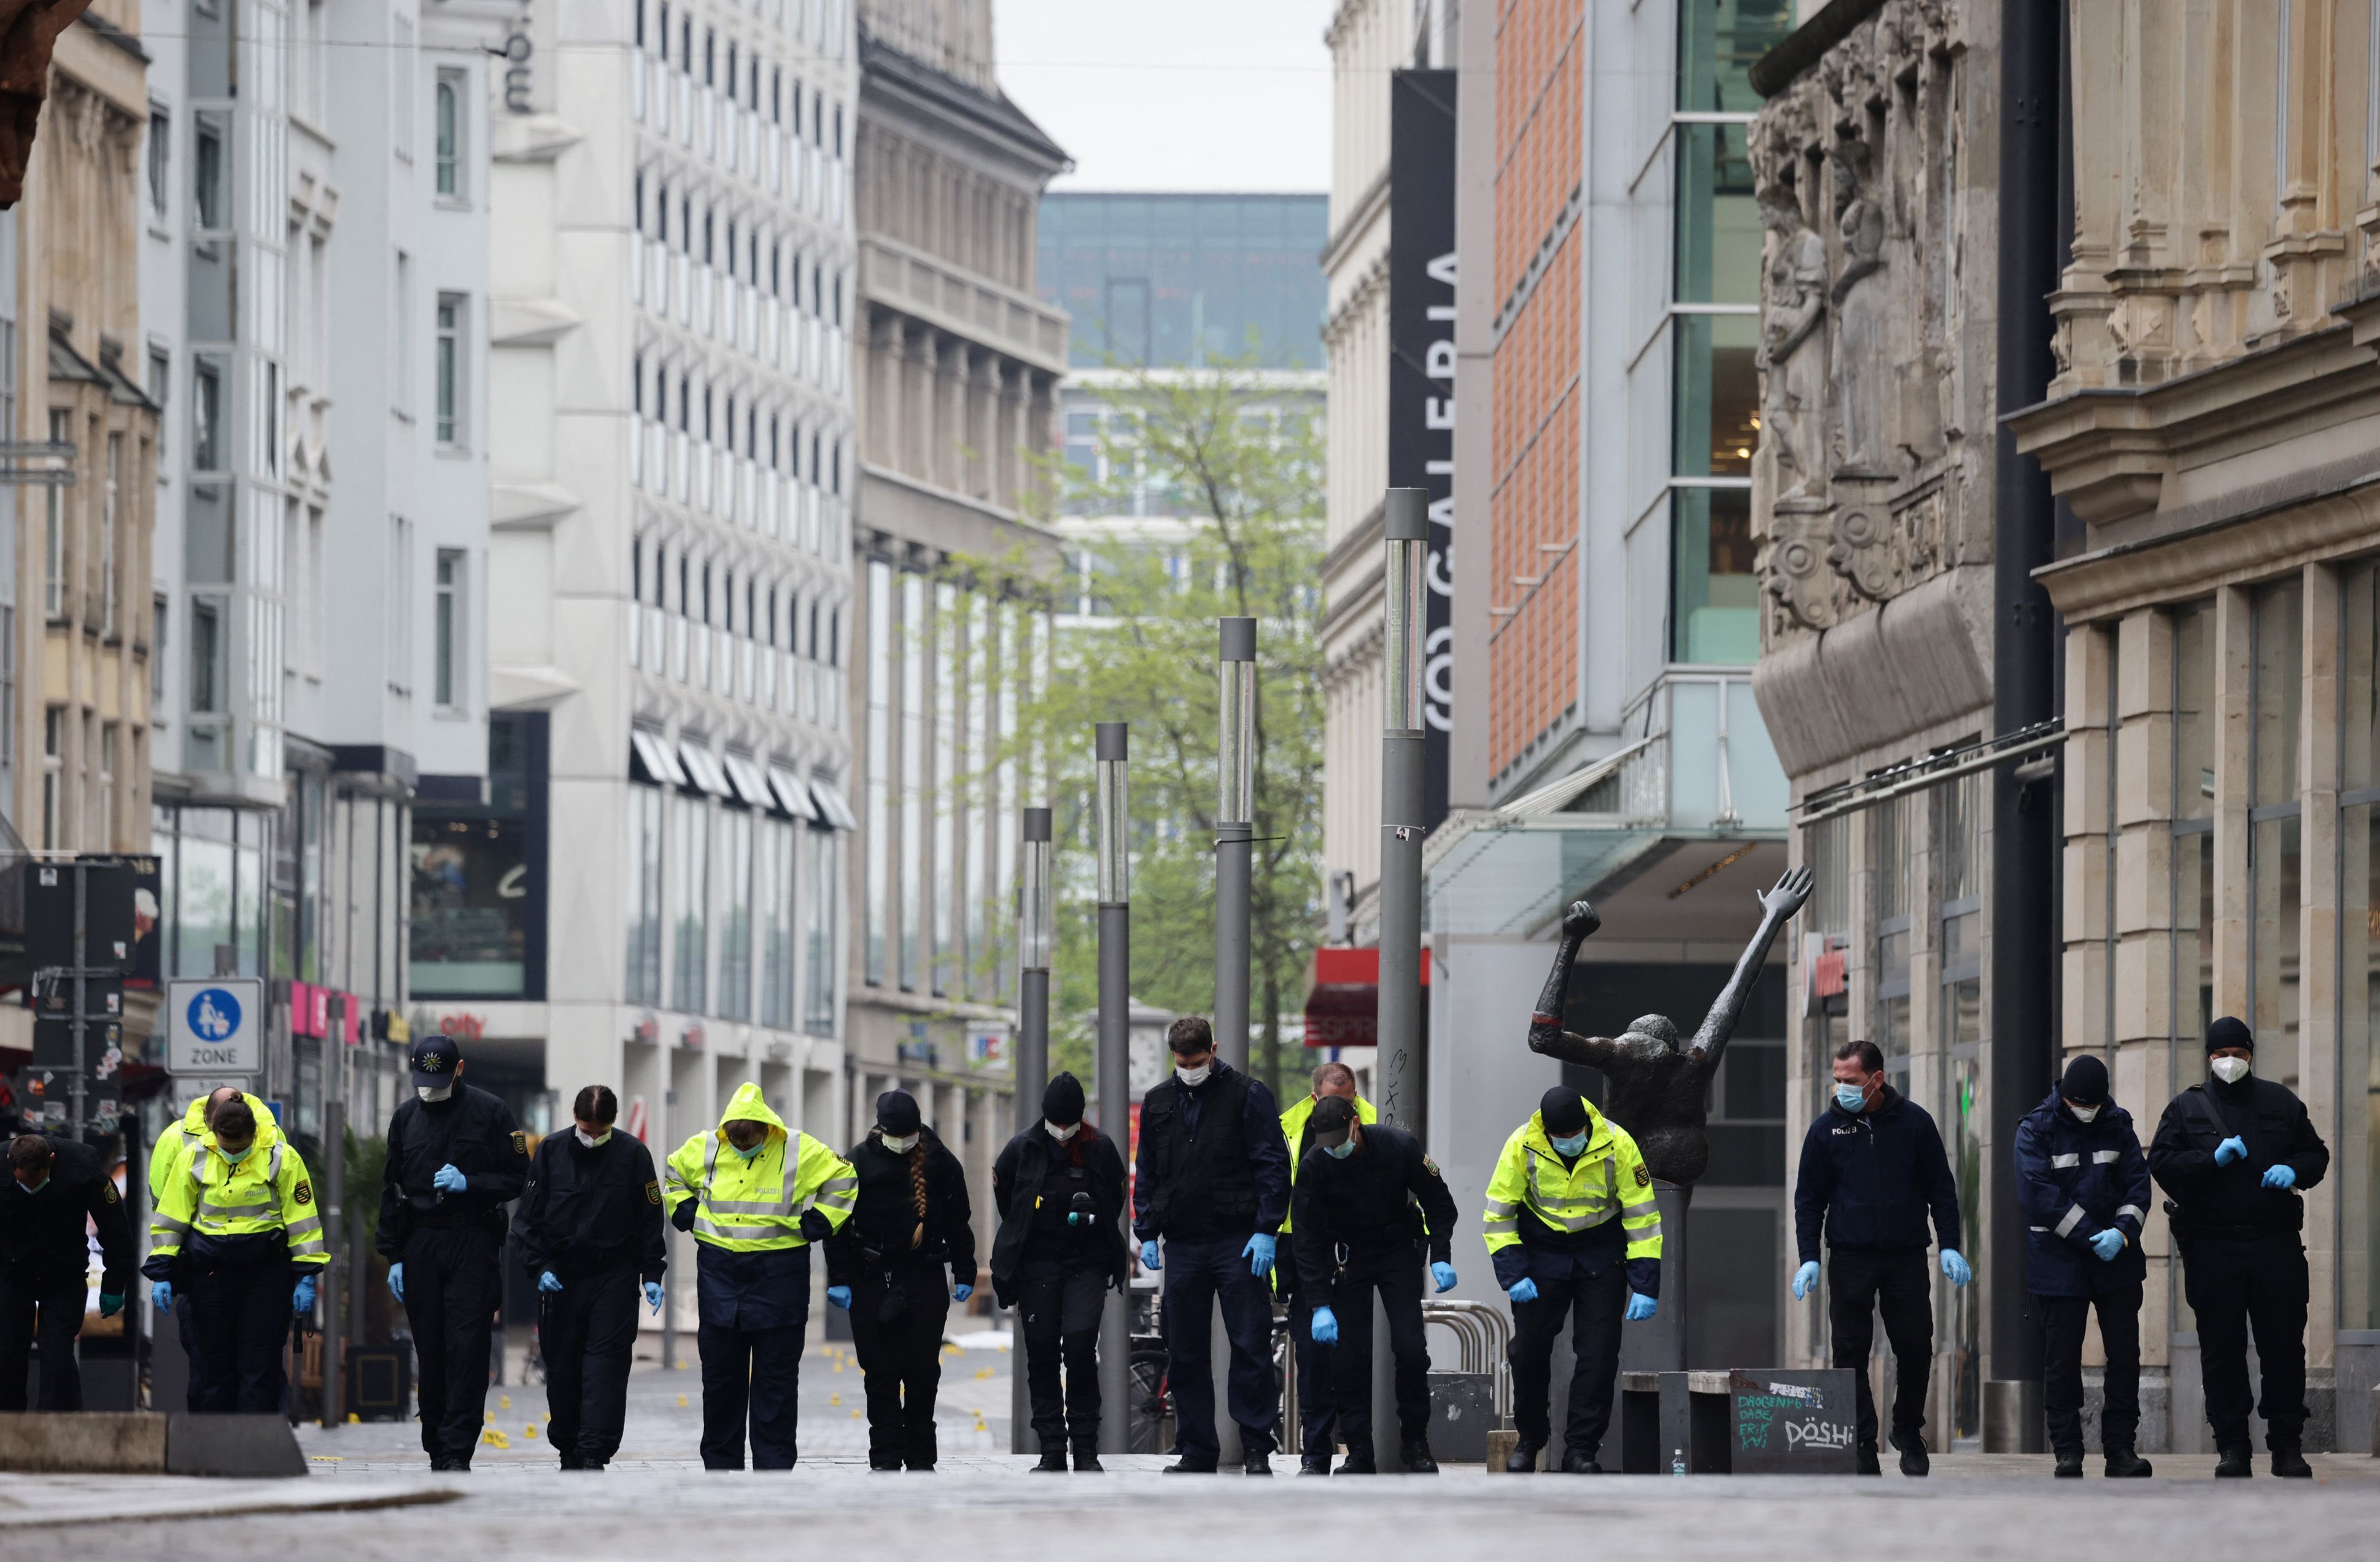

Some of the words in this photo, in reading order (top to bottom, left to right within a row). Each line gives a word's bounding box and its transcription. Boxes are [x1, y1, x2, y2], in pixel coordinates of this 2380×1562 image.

[440, 1010, 487, 1041] city
[1305, 1014, 1376, 1042] ESPR
[191, 1048, 238, 1064] ZONE
